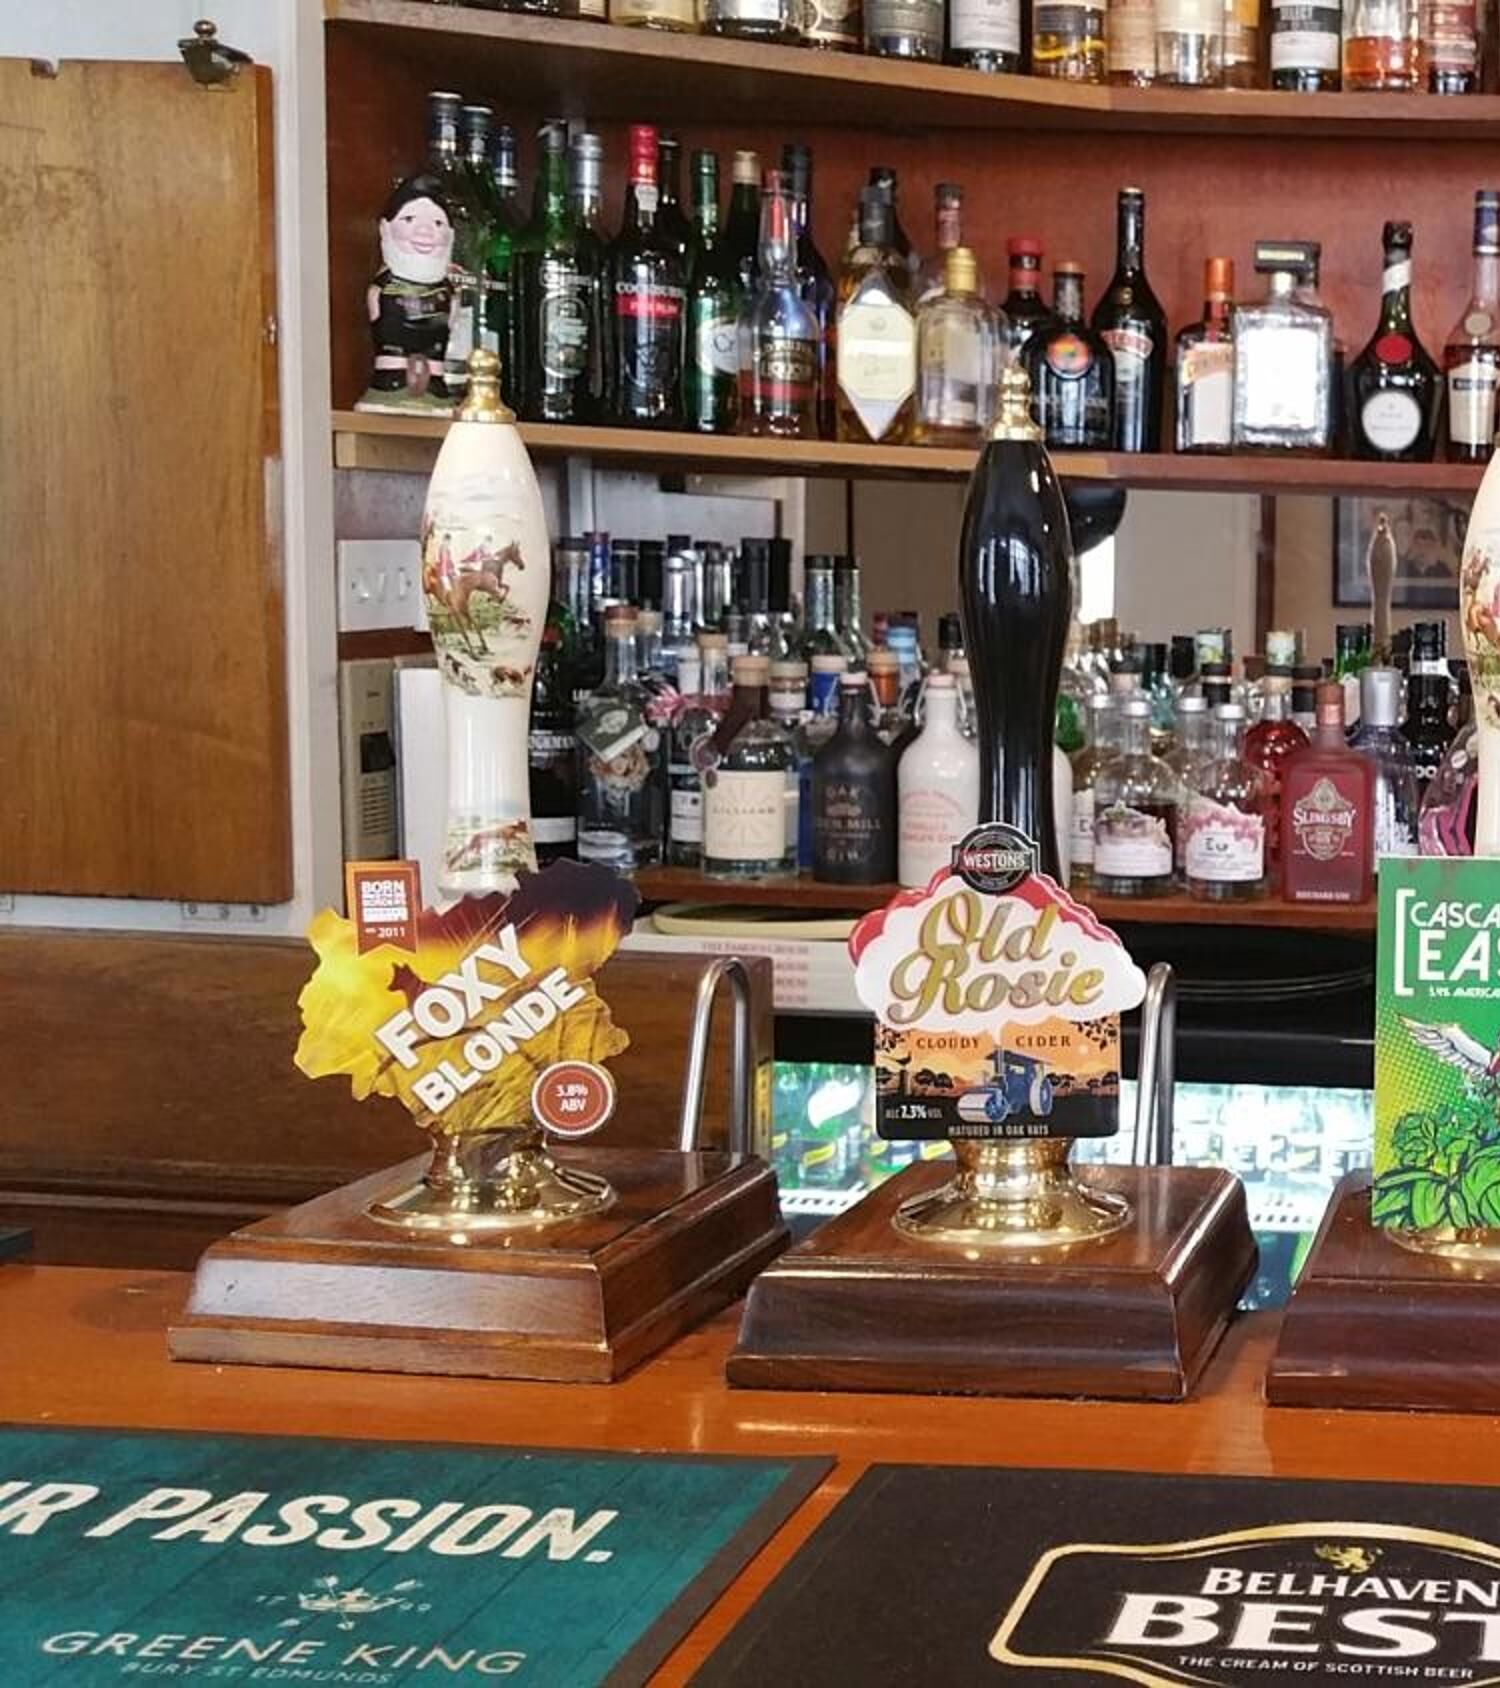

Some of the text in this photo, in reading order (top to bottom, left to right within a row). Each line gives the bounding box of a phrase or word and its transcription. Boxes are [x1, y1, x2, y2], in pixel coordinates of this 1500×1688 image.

[1293, 806, 1357, 828] SLINGSBY
[361, 879, 406, 893] BORN
[377, 927, 406, 939] 2011
[919, 889, 1061, 963] Old
[375, 922, 532, 1071] FOXY
[887, 943, 1105, 1025] Rosie
[411, 965, 587, 1115] BLONDE
[916, 1035, 1072, 1049] CLOUDY CIDER
[556, 1084, 589, 1098] 3.8%
[560, 1098, 587, 1112] ABV
[948, 1125, 1050, 1137] MATURED IN OAK VATS
[84, 1487, 619, 1563] PASSION.
[1200, 1566, 1500, 1608] BELHAVEN
[41, 1630, 529, 1675] GREENE KING
[121, 1661, 394, 1686] BURY ST EDMUNDS
[1177, 1655, 1474, 1681] THE CREAM OF SCOTTISH BEER
